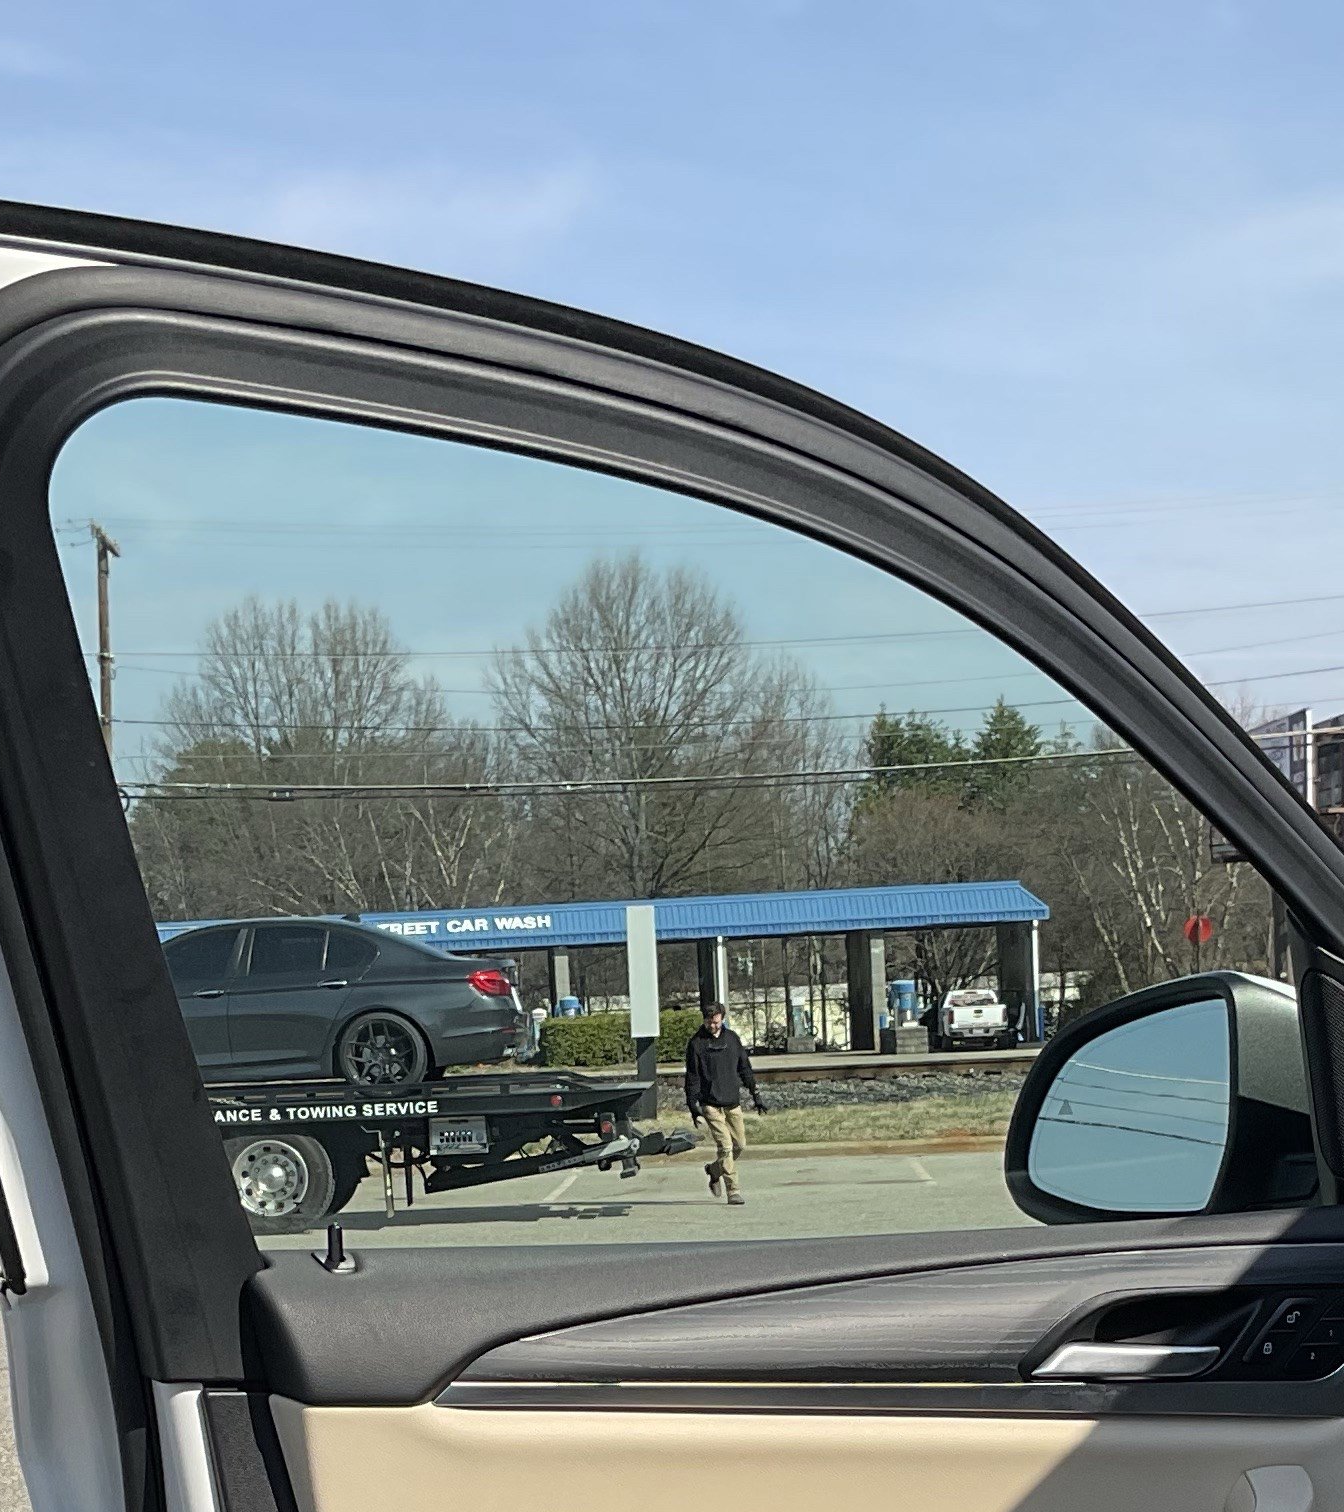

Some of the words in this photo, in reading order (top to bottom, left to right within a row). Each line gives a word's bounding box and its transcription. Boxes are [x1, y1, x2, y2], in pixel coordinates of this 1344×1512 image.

[446, 918, 489, 933] CAR
[494, 915, 552, 930] WASH
[214, 1108, 263, 1123] ANCE
[268, 1108, 282, 1121] &
[285, 1105, 357, 1121] TOWING
[362, 1100, 439, 1117] SERVICE
